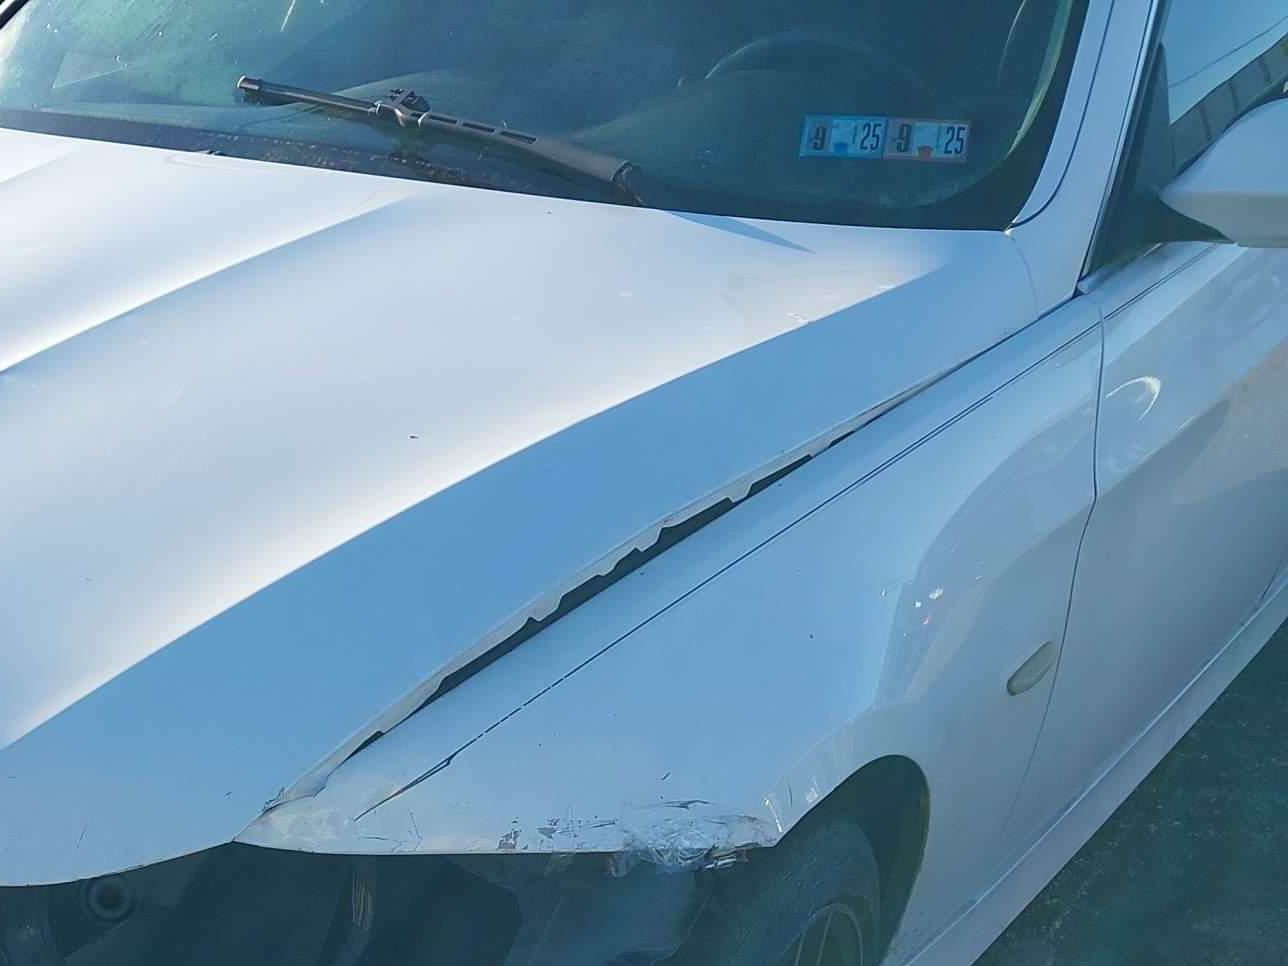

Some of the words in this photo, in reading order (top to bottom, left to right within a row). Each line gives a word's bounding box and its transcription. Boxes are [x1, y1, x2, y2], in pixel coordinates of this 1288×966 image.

[812, 126, 827, 151] 9
[859, 123, 882, 151] 25
[896, 123, 913, 152] 9
[944, 126, 966, 154] 25
